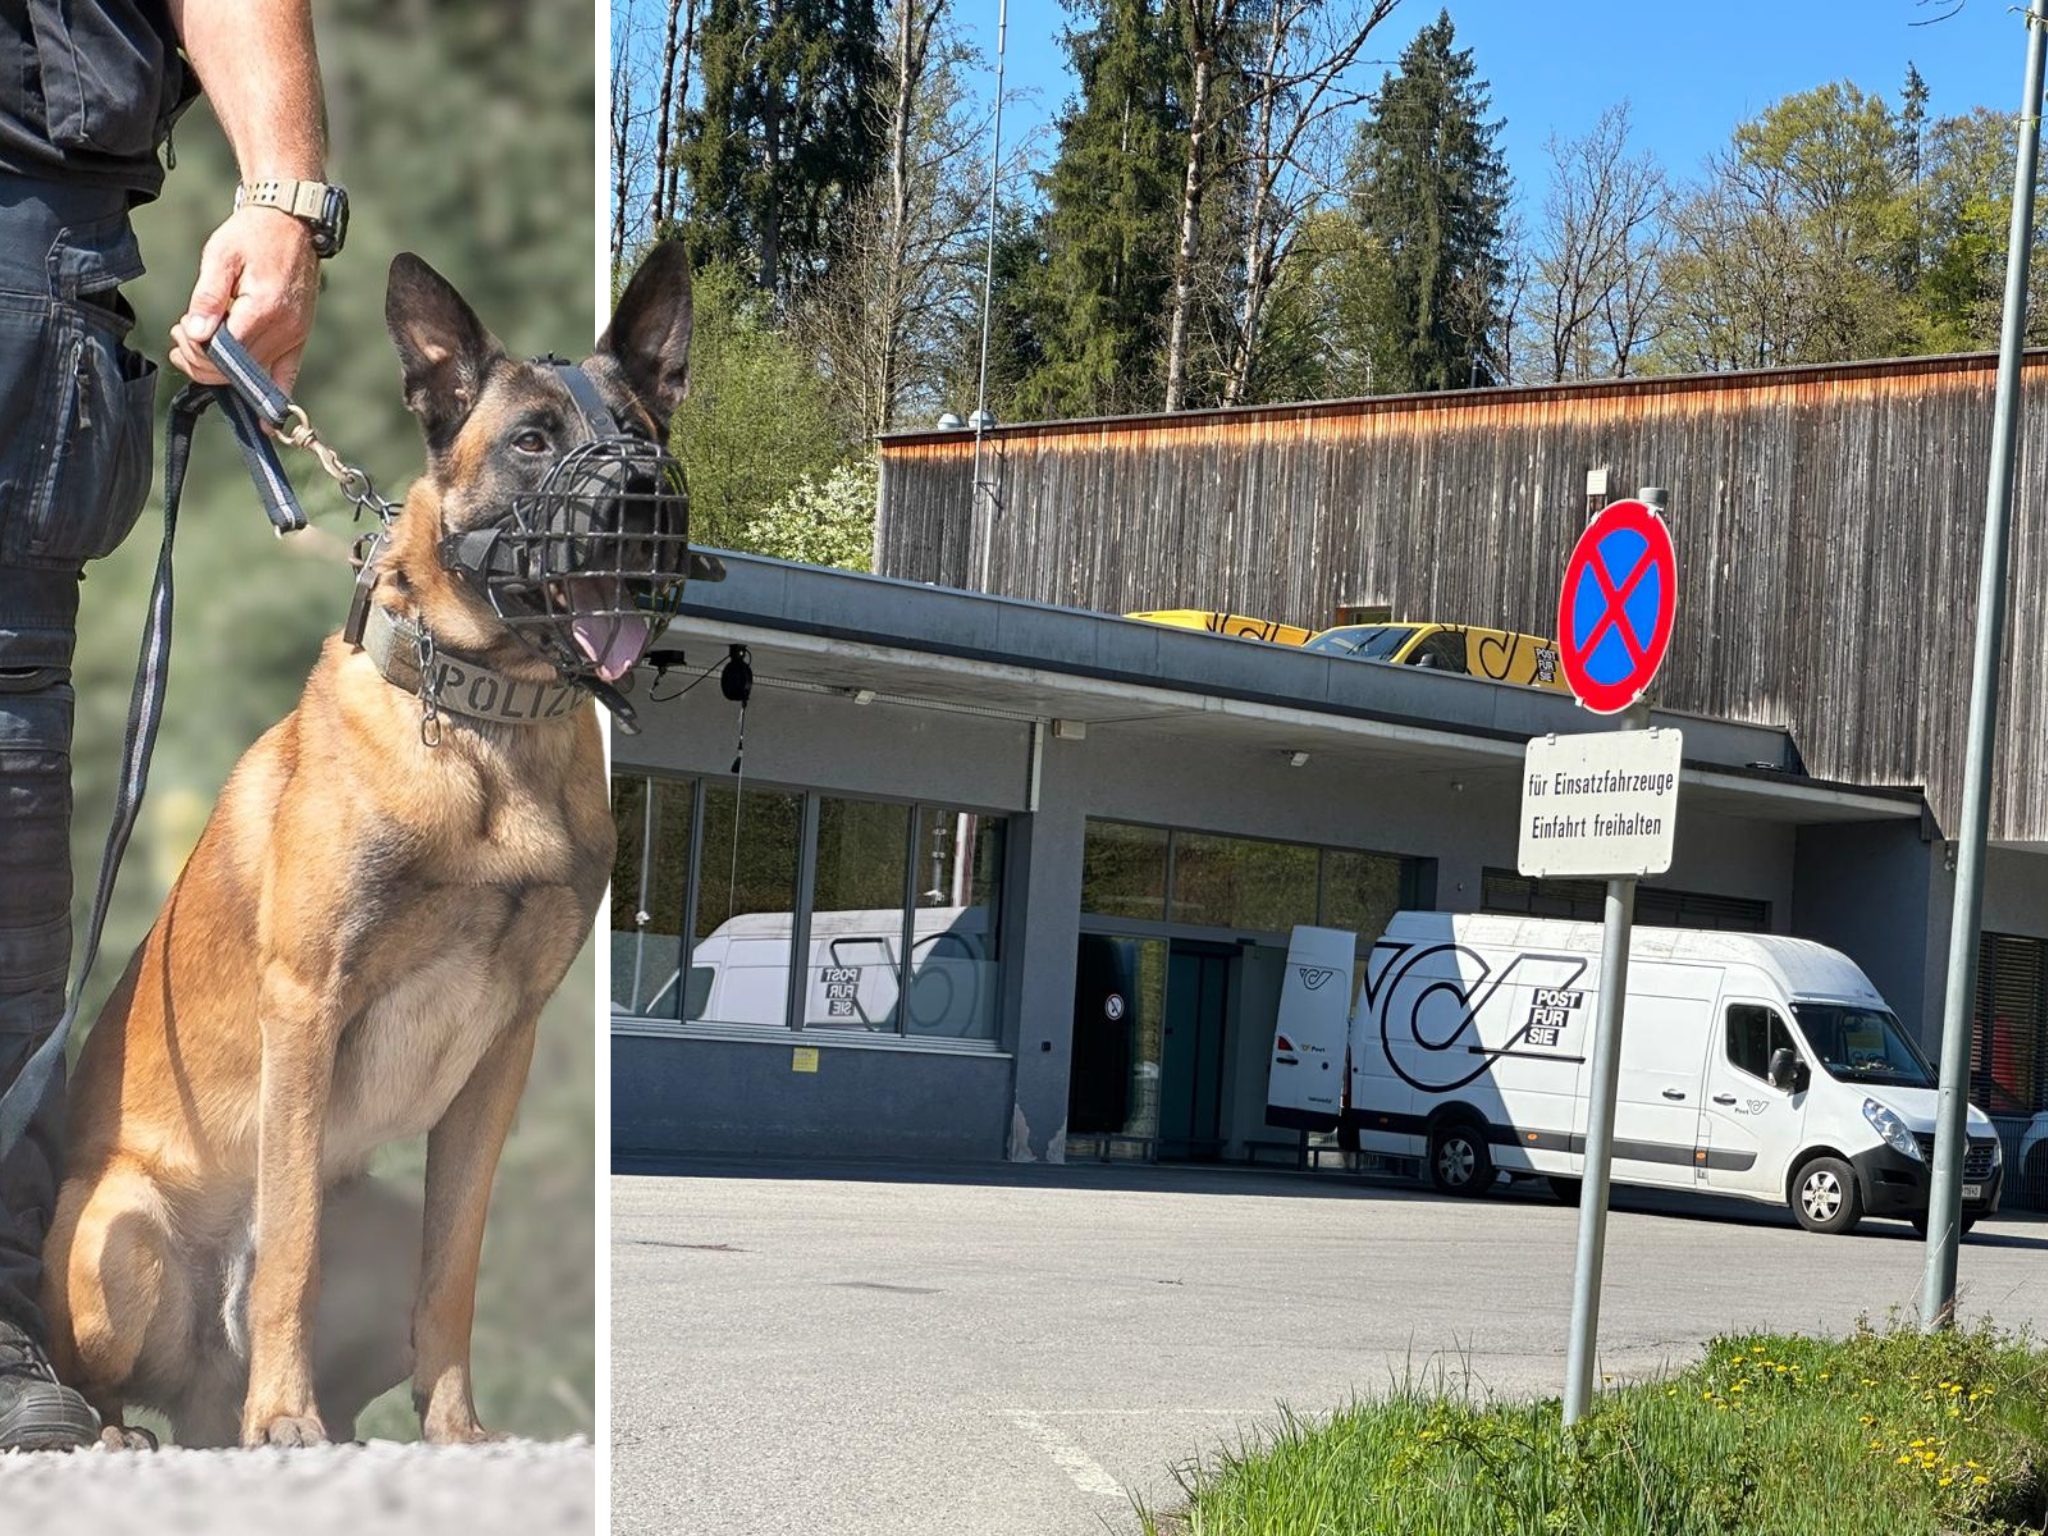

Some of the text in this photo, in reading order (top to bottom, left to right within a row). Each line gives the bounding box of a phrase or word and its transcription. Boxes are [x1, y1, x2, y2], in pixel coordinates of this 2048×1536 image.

[1528, 769, 1674, 797] für Einsatzfahrzeuge
[1532, 812, 1661, 839] Einfahrt freihalten
[1536, 989, 1580, 1007] POST
[1528, 1027, 1556, 1045] SIE
